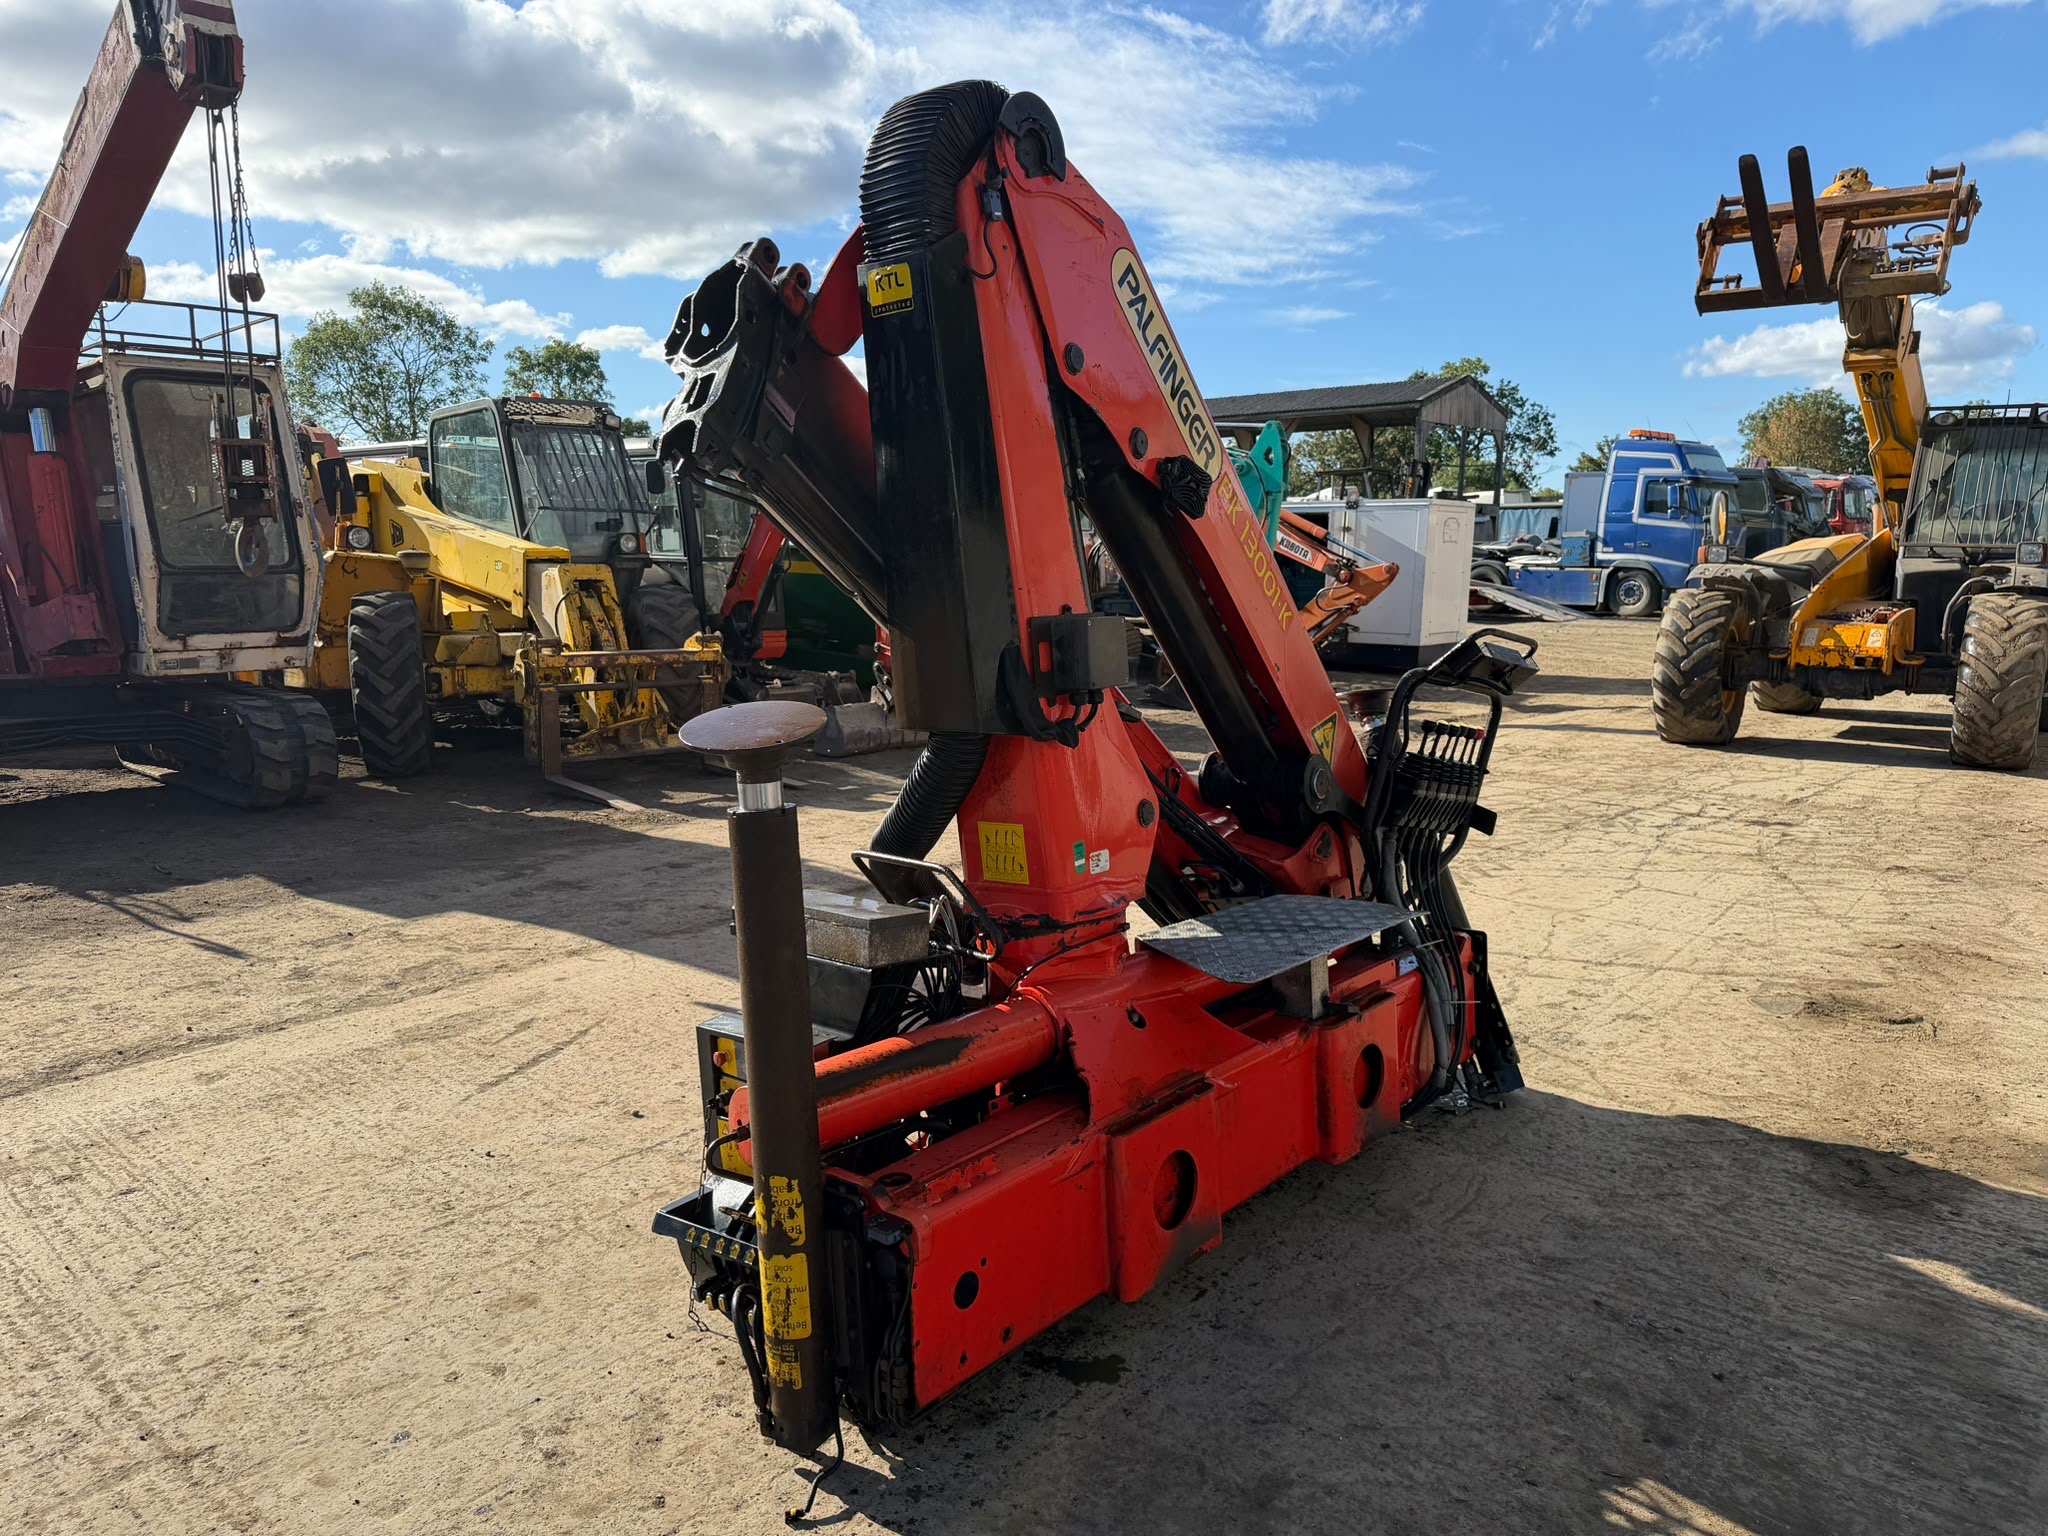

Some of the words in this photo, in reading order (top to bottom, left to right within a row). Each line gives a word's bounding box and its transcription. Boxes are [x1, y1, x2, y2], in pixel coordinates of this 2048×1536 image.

[875, 272, 904, 293] KTL
[1117, 262, 1216, 471] PALFINGER
[1218, 476, 1244, 526] PK
[1279, 536, 1310, 560] KUBOTA
